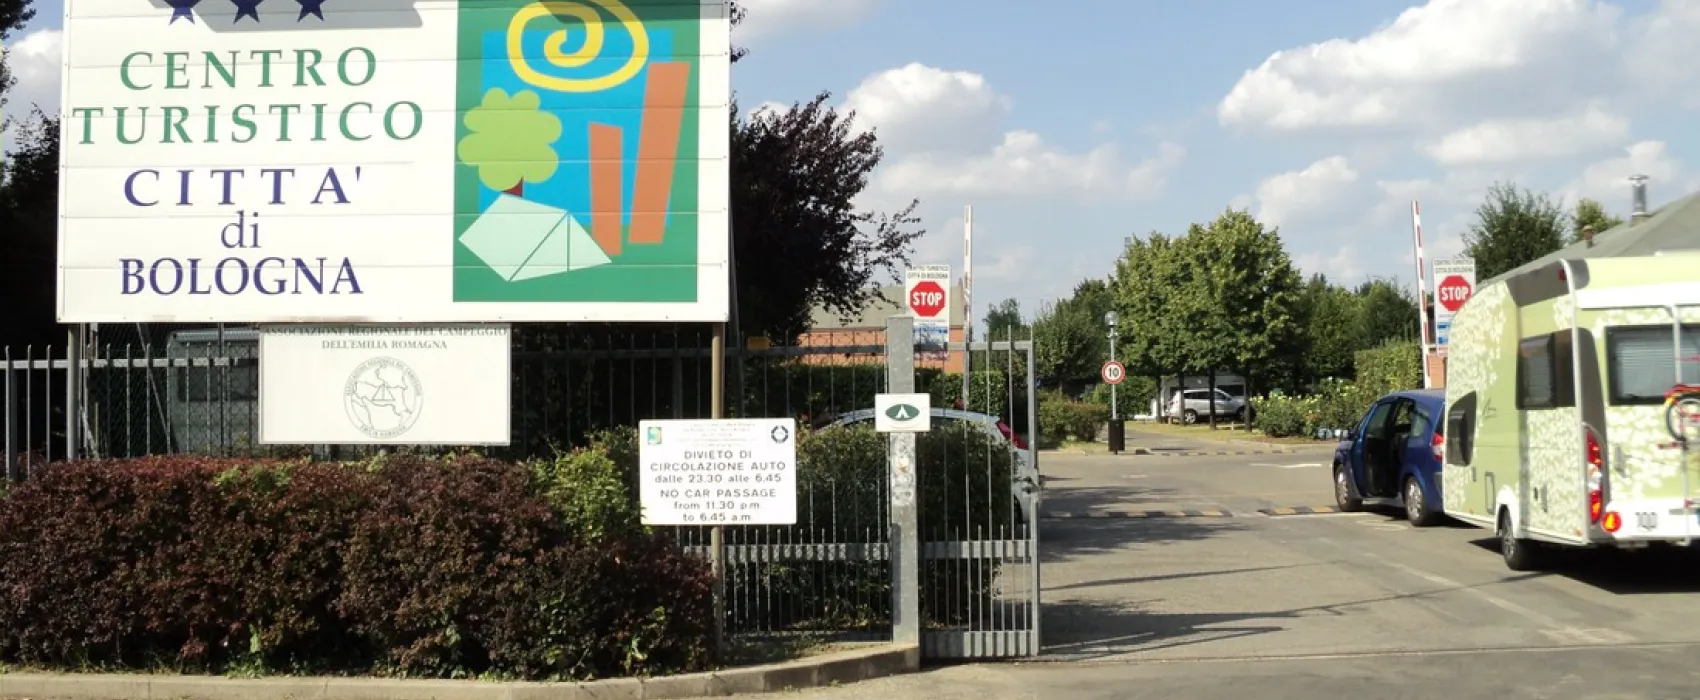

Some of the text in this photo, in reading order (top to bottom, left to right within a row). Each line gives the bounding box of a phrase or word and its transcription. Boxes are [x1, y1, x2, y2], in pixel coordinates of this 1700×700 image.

[121, 47, 375, 90] CENTRO
[73, 101, 422, 144] TURISTICO
[125, 167, 360, 206] CITTA'
[221, 210, 260, 248] di
[120, 257, 362, 295] BOLOGNA
[912, 291, 942, 306] STOP
[1441, 287, 1469, 301] STOP
[391, 340, 447, 349] ROMAGNA
[1108, 367, 1120, 378] 10
[684, 450, 752, 459] DIVIETO DI
[650, 461, 786, 472] CIRCOLAZIONE AUTO
[655, 473, 782, 483] dalle 23.30 alle 6.45
[660, 488, 776, 498] NO CAR PASSAGE
[674, 501, 700, 510] from
[683, 513, 695, 522] to
